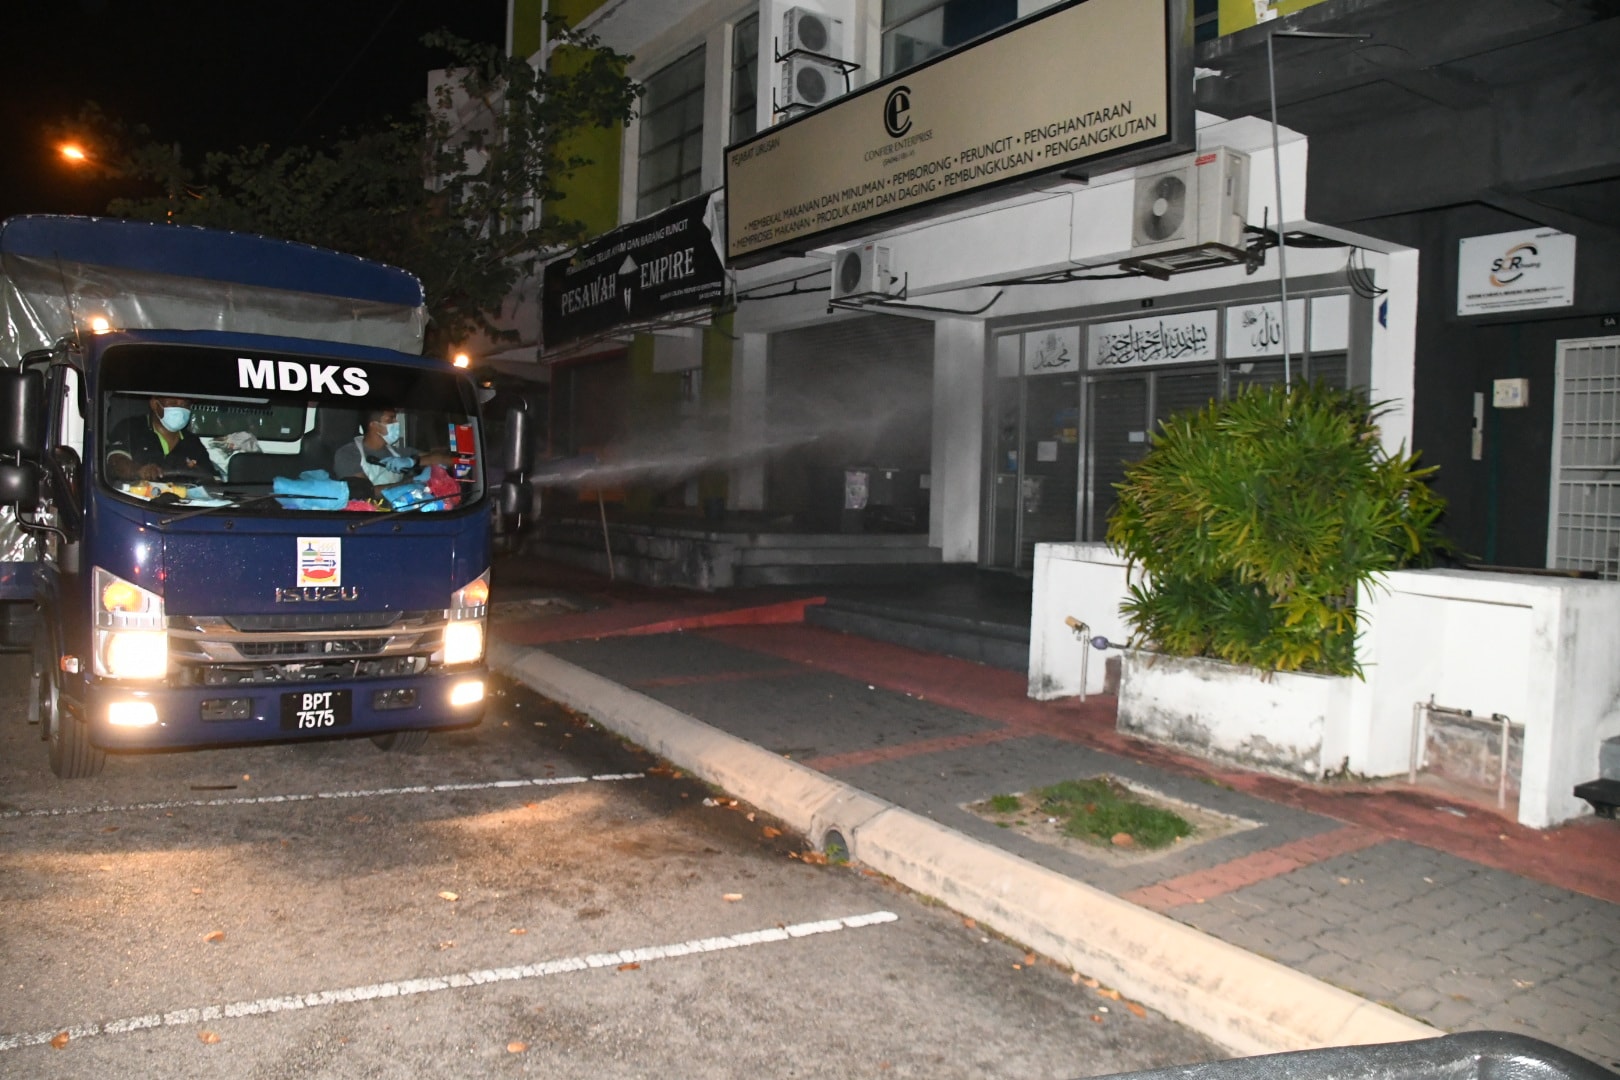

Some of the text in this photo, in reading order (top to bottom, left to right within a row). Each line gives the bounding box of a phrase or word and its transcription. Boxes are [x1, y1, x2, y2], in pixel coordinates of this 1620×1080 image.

[894, 129, 934, 151] ENTERPRISE
[747, 213, 782, 231] MEMBEKAL
[783, 201, 820, 222] MAKANAN
[821, 193, 840, 208] DAN
[842, 179, 885, 201] MINUMAN
[892, 156, 951, 185] PEMBORONG
[960, 136, 1013, 164] PERUNCIT
[1024, 100, 1132, 145] PENGHANTARAN
[736, 114, 1157, 248] MEMPROSES MAKANAN PRODUK AYAM DAN DAGING PEMBUNGKUSAN PENGANGKUTAN
[627, 238, 640, 251] DAN
[561, 273, 617, 316] PESAWAH
[640, 247, 695, 289] EMPIRE
[237, 357, 370, 397] MDKS
[275, 587, 359, 602] ISUZU
[302, 692, 333, 711] BPT
[296, 709, 335, 729] 7575
